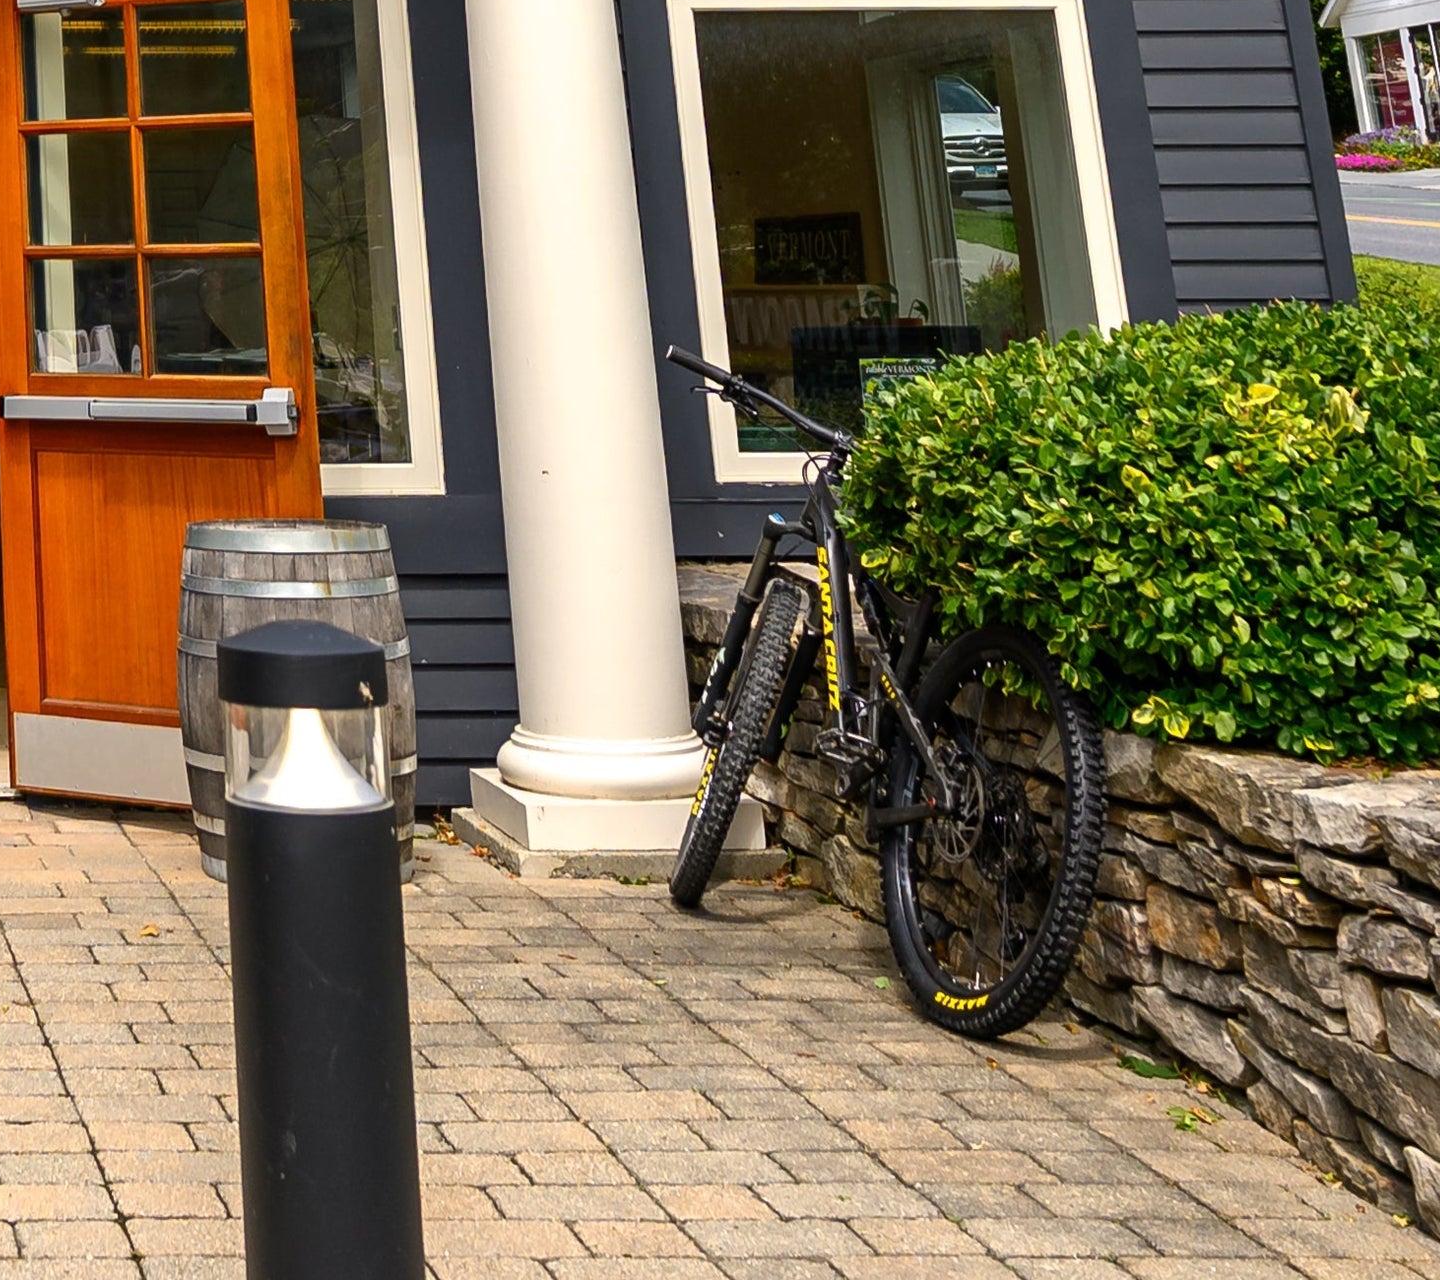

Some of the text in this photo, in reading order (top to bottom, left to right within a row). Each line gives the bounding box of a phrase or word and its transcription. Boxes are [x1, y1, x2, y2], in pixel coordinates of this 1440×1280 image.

[767, 229, 852, 261] VERMONT
[816, 546, 842, 712] SANTA CRUZ
